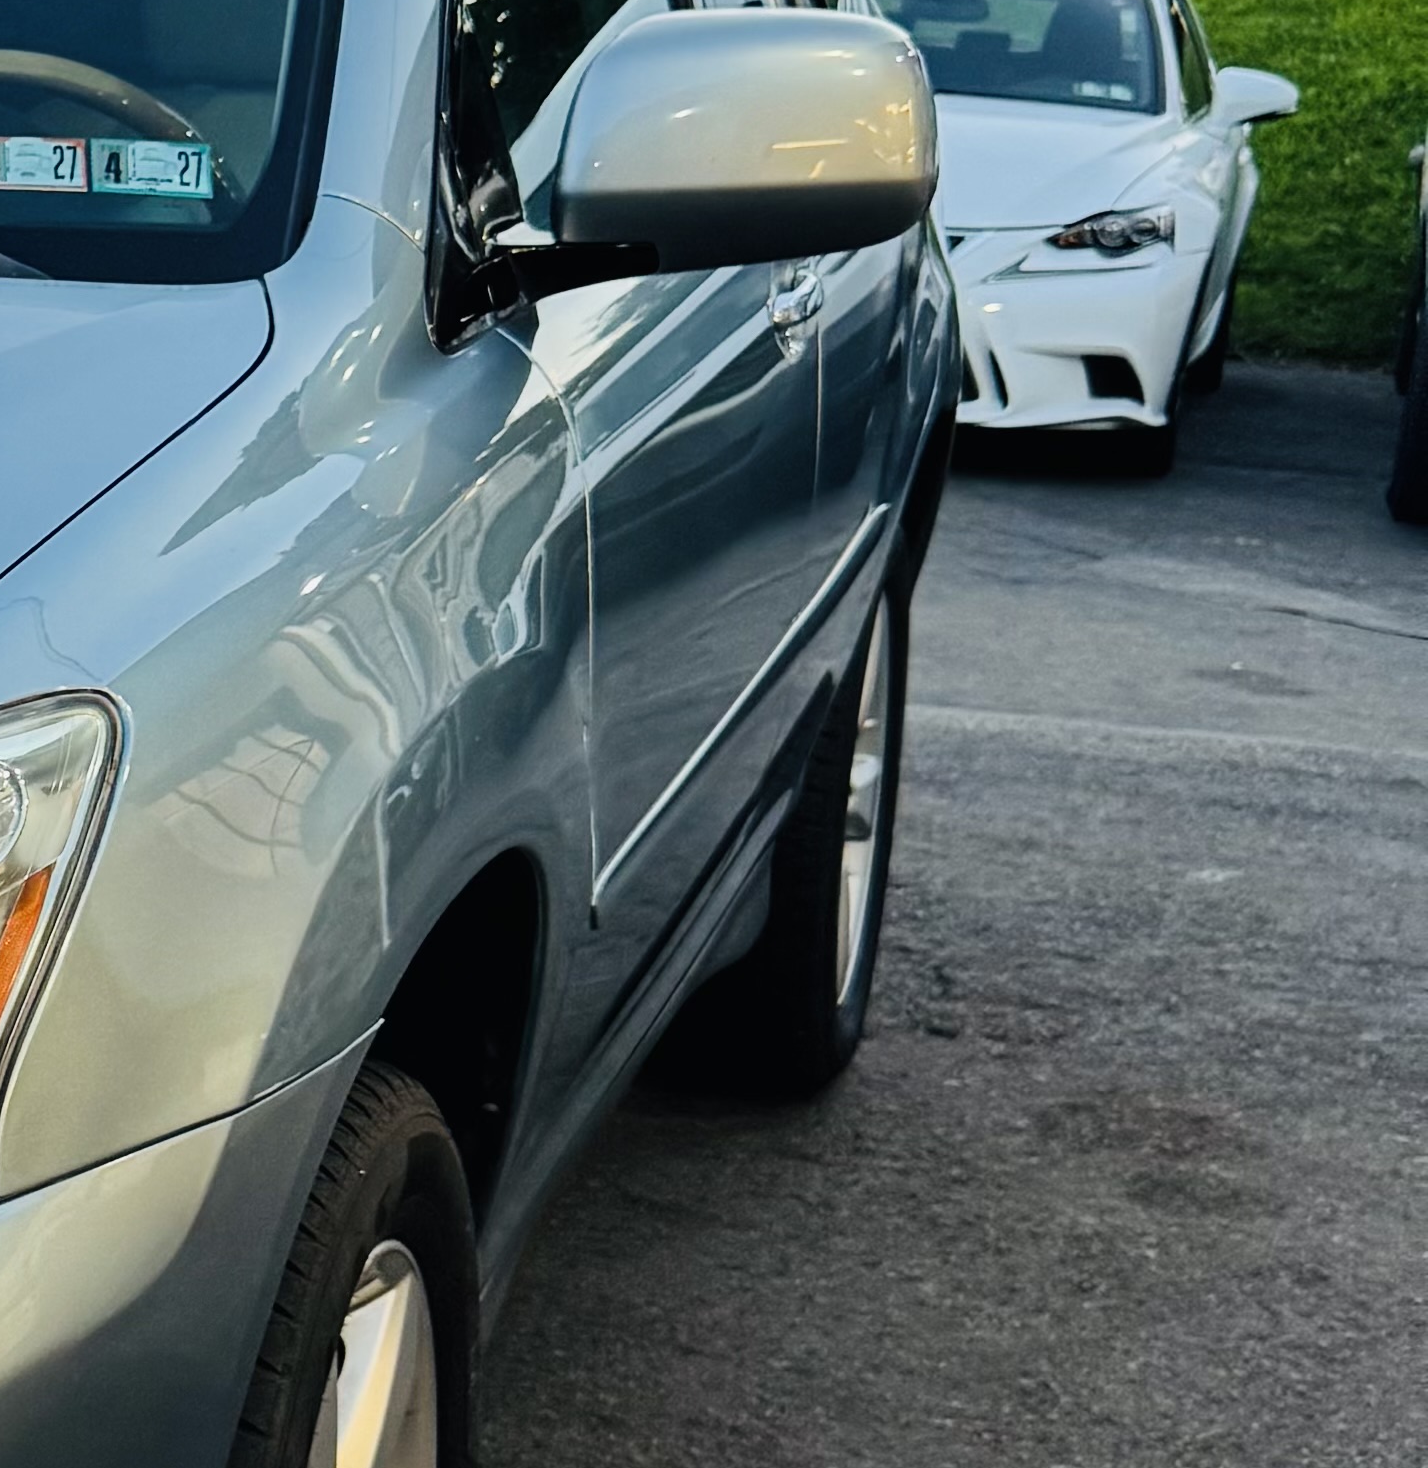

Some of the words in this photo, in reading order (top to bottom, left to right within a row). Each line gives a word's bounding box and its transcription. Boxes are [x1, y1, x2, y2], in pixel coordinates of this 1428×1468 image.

[52, 145, 77, 182] 27
[104, 151, 123, 184] 4
[177, 150, 202, 190] 27
